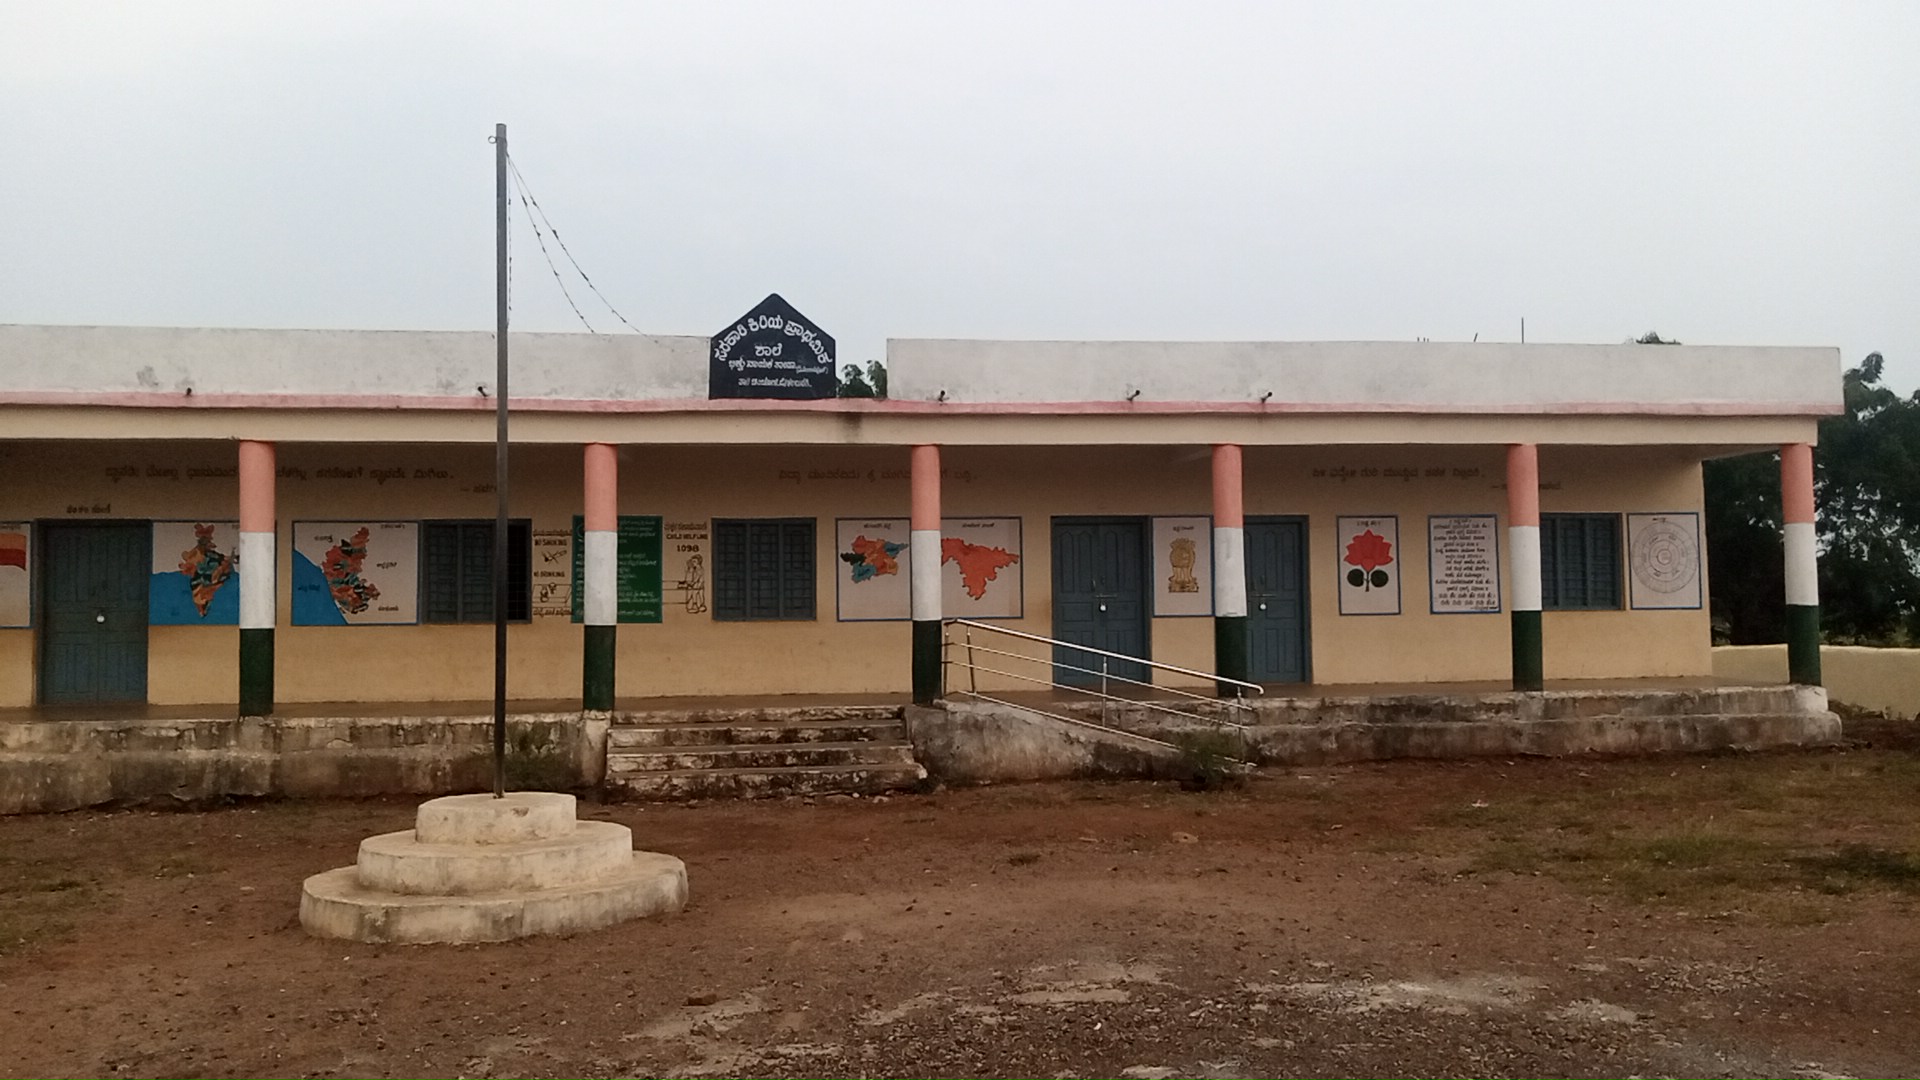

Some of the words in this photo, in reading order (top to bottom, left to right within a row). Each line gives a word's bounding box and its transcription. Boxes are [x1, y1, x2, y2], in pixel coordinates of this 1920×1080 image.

[714, 323, 748, 361] ಸರಕಾರಿ
[747, 314, 784, 332] ಕಿರಿಯ
[784, 319, 833, 364] ಪ್ರಾಥಮಿಕ
[755, 342, 783, 357] ಶಾಲೆ
[676, 544, 699, 553] 1098
